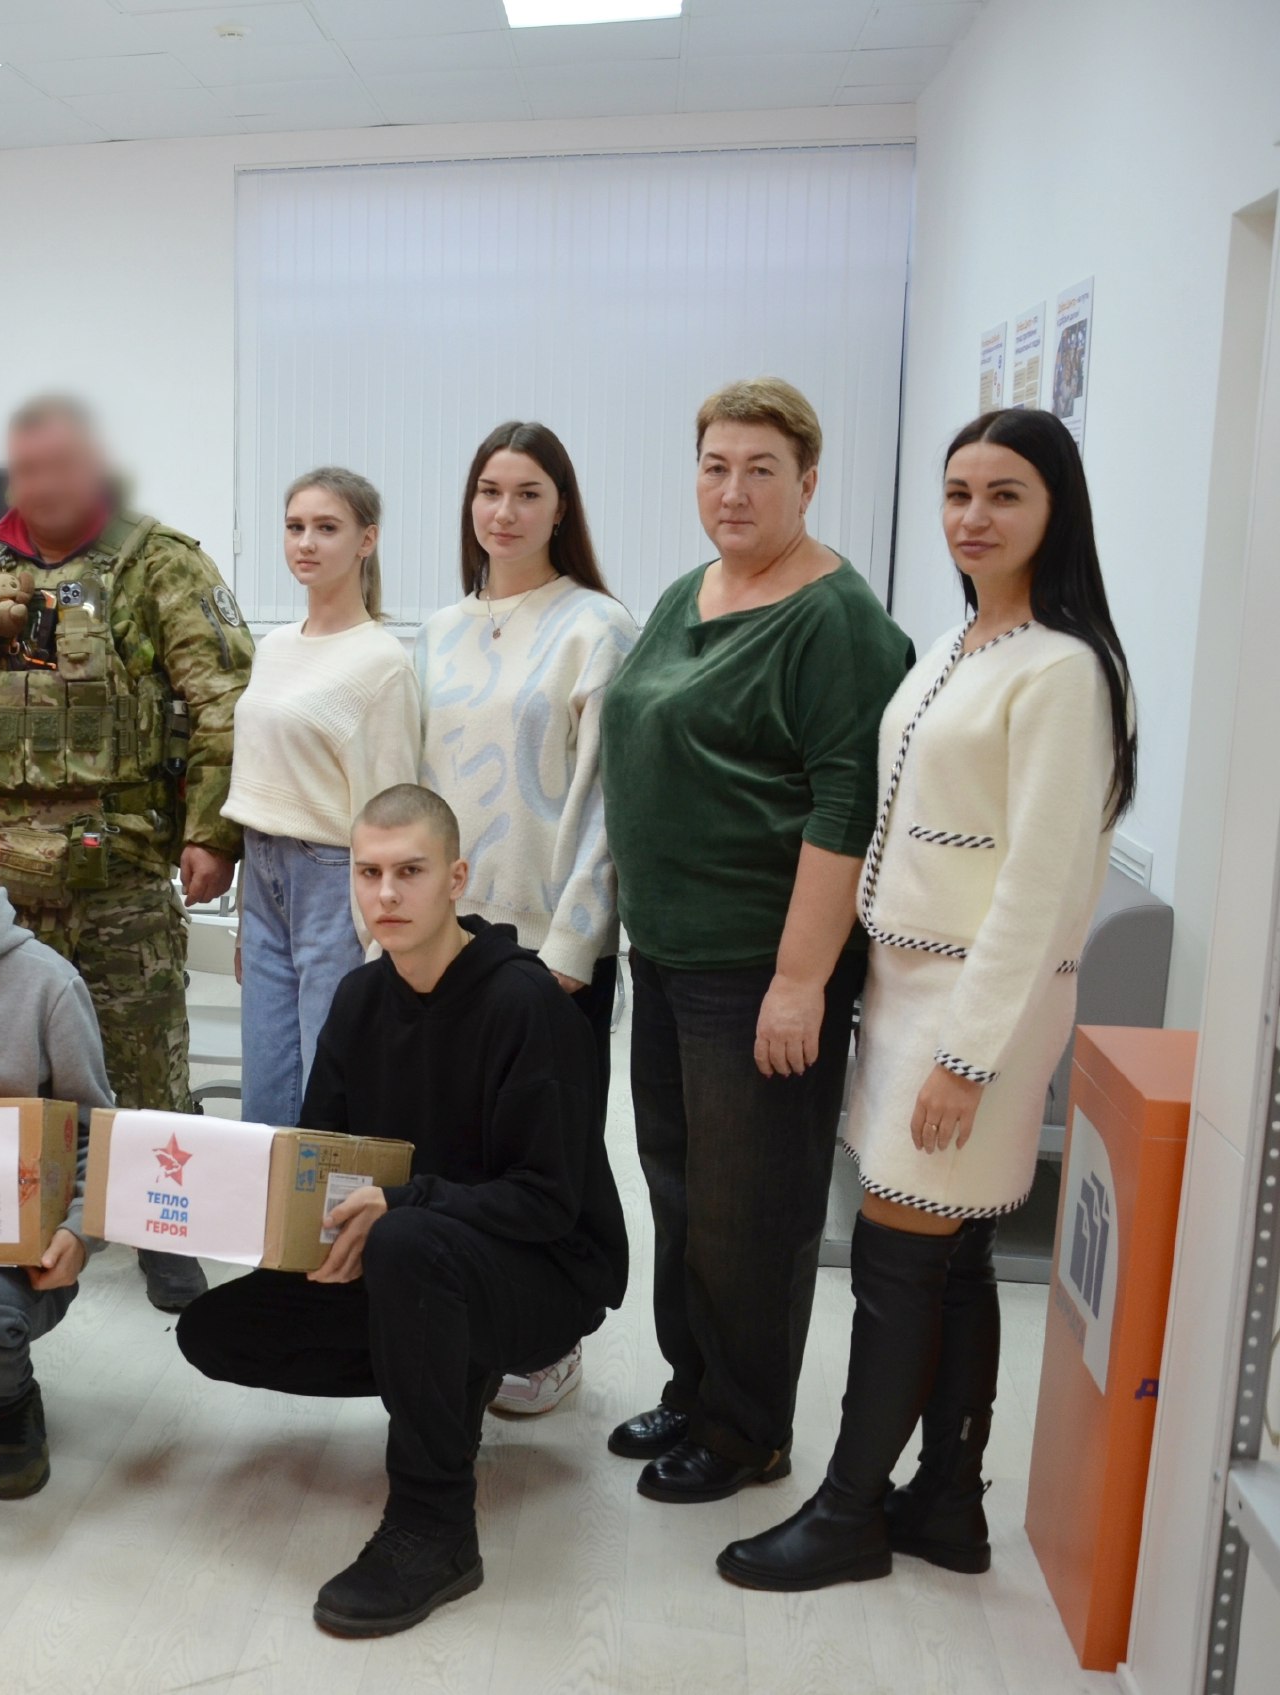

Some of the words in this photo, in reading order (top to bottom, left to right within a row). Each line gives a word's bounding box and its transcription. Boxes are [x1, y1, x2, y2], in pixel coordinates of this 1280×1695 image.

[147, 1191, 189, 1208] ТЕПЛО
[160, 1208, 188, 1223] ДЛЯ
[146, 1220, 188, 1238] ГЕРОЯ
